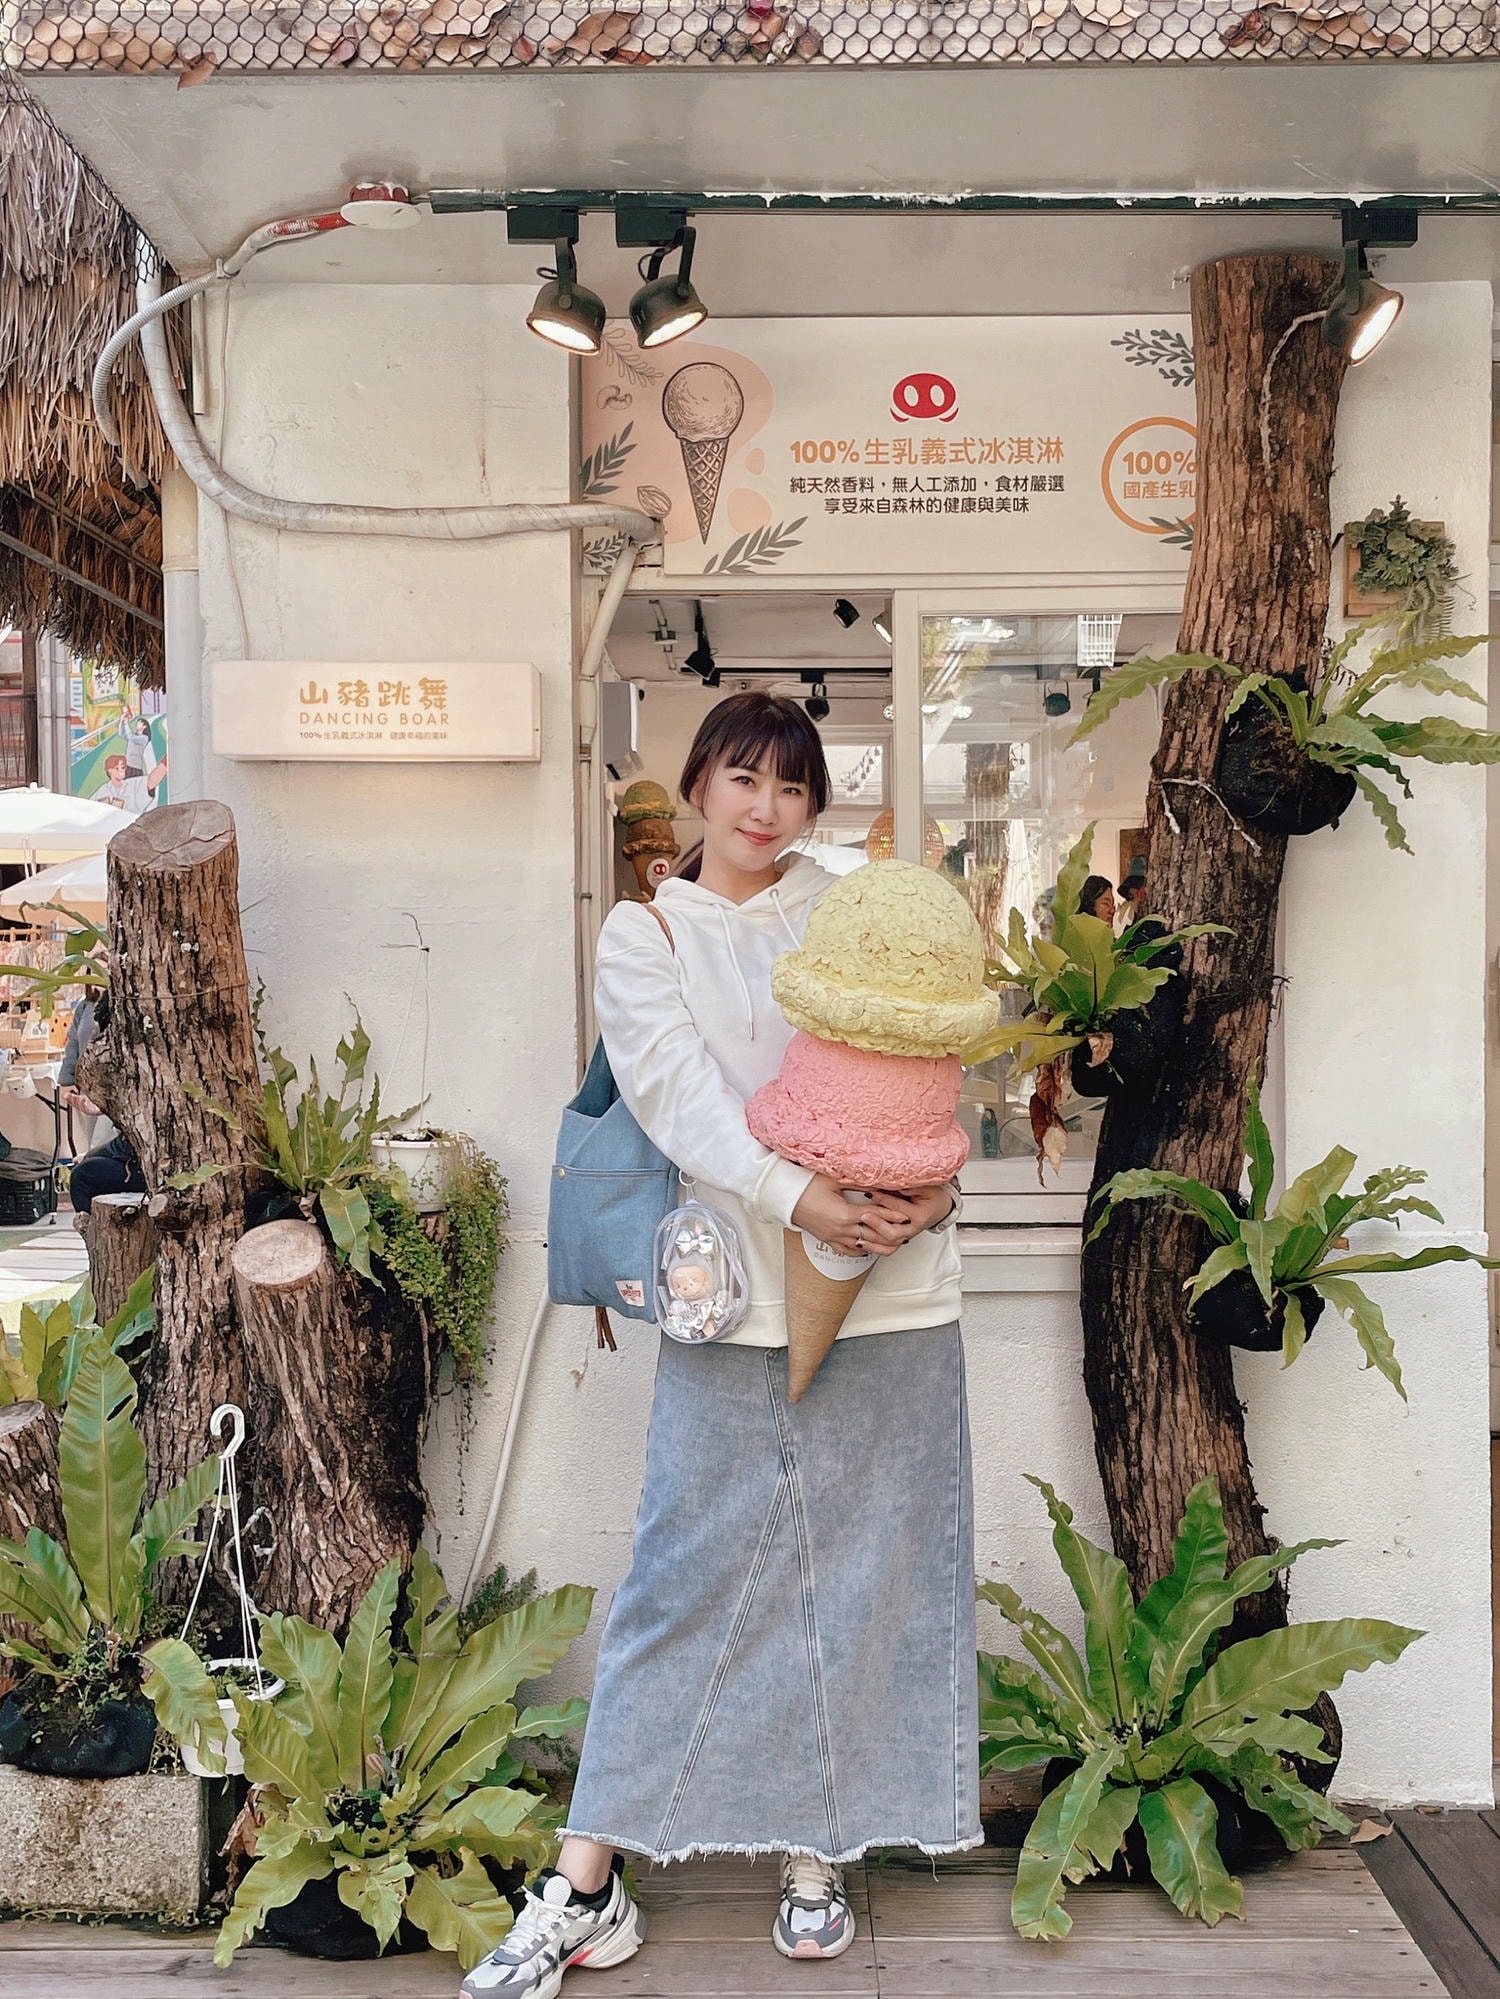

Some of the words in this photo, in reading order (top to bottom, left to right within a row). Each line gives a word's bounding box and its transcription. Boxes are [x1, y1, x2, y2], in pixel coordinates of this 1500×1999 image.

[790, 437, 1065, 465] 100%生乳義式冰淇淋
[1122, 449, 1197, 475] 100%
[1123, 480, 1196, 499] 國產生乳
[824, 496, 1030, 514] 享受來自森林的健康與美味
[299, 677, 448, 710] 山豬跳舞
[299, 712, 389, 725] DANCING
[399, 712, 449, 725] BOAR
